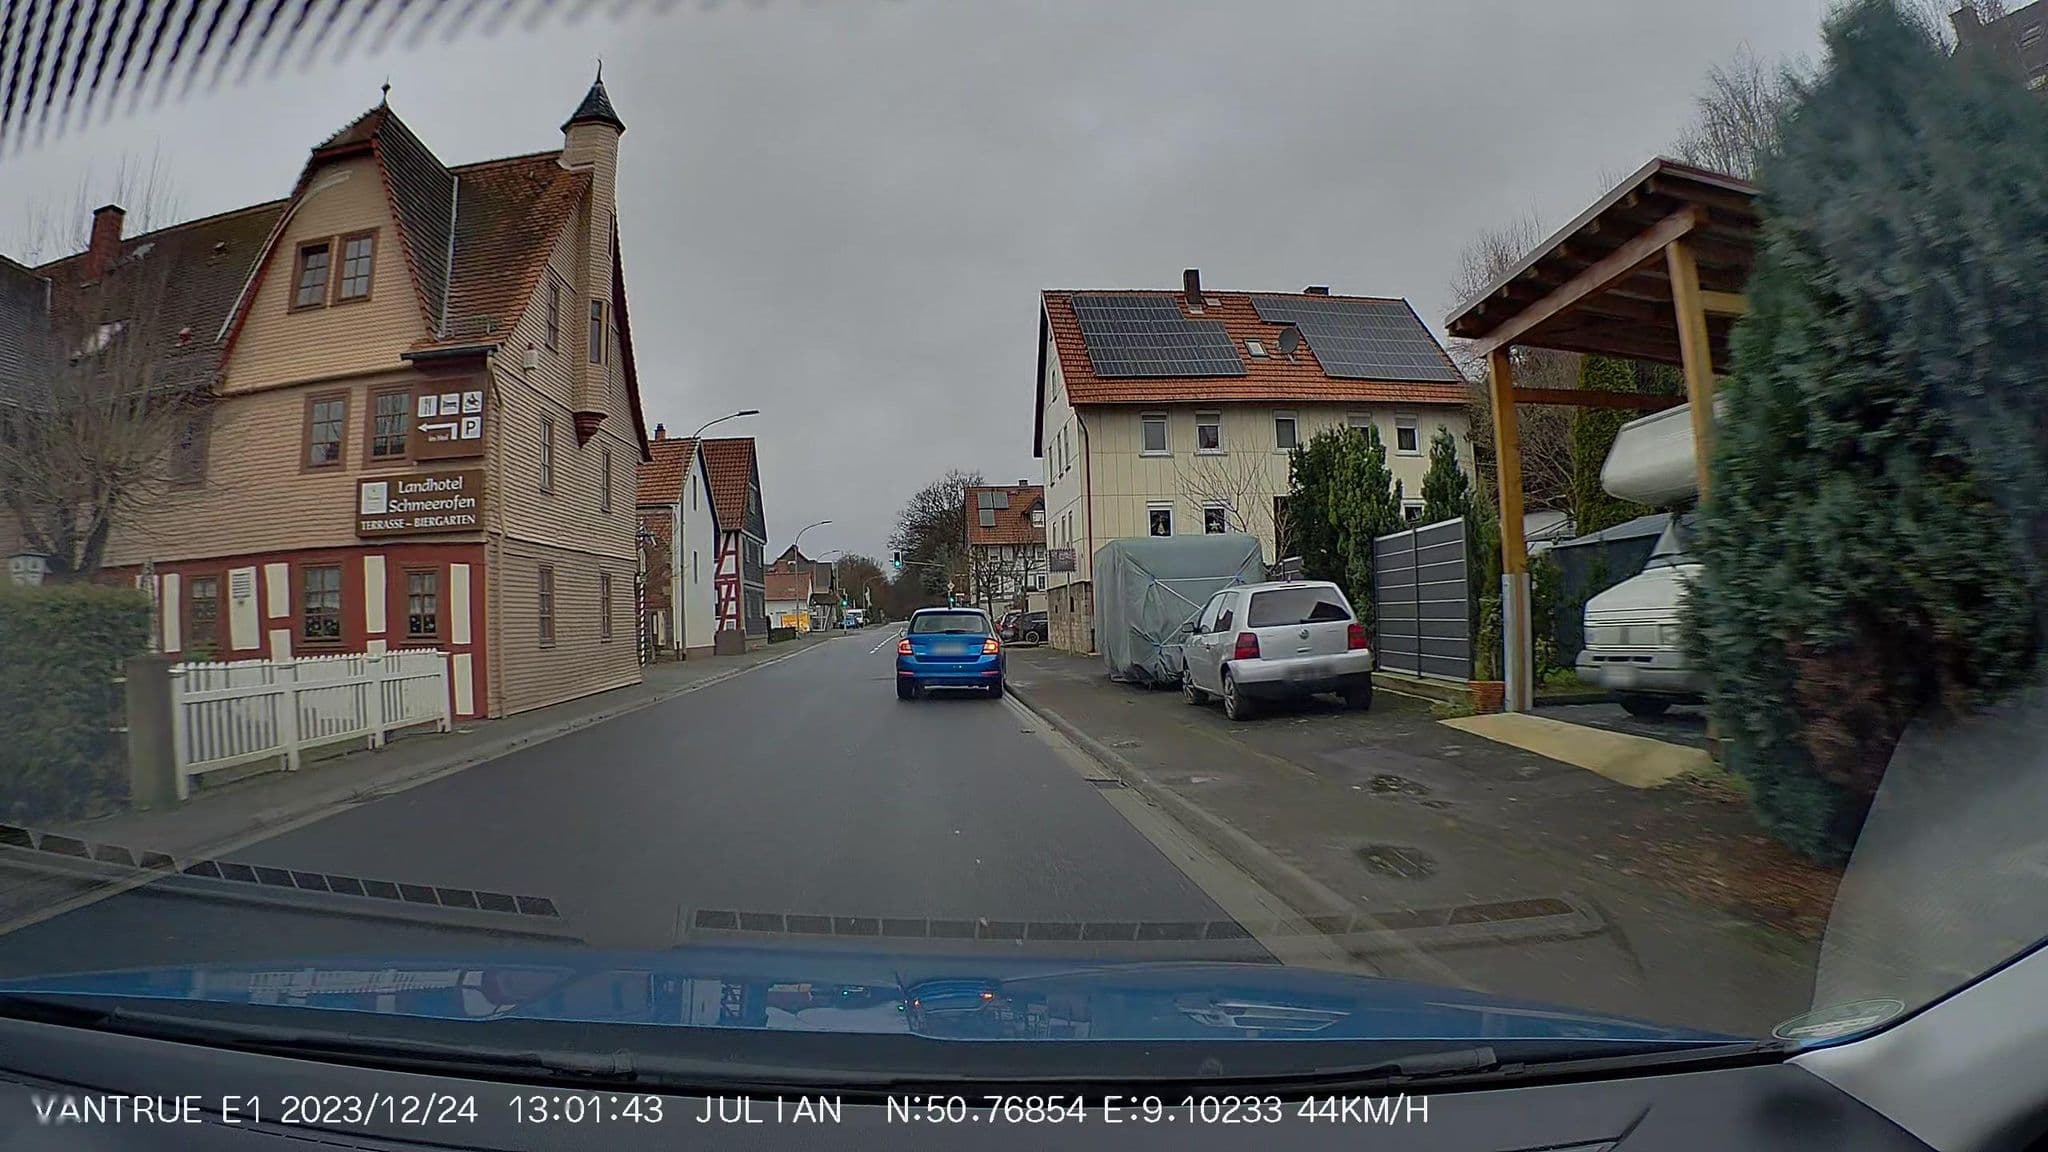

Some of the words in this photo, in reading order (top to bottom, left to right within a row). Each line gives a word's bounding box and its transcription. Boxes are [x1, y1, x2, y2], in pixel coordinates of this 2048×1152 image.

[466, 421, 476, 435] P
[398, 476, 464, 494] Landhotel
[388, 495, 476, 513] Schmeerofen
[361, 518, 405, 531] TERRASSE
[414, 514, 476, 528] BIERGARTEN
